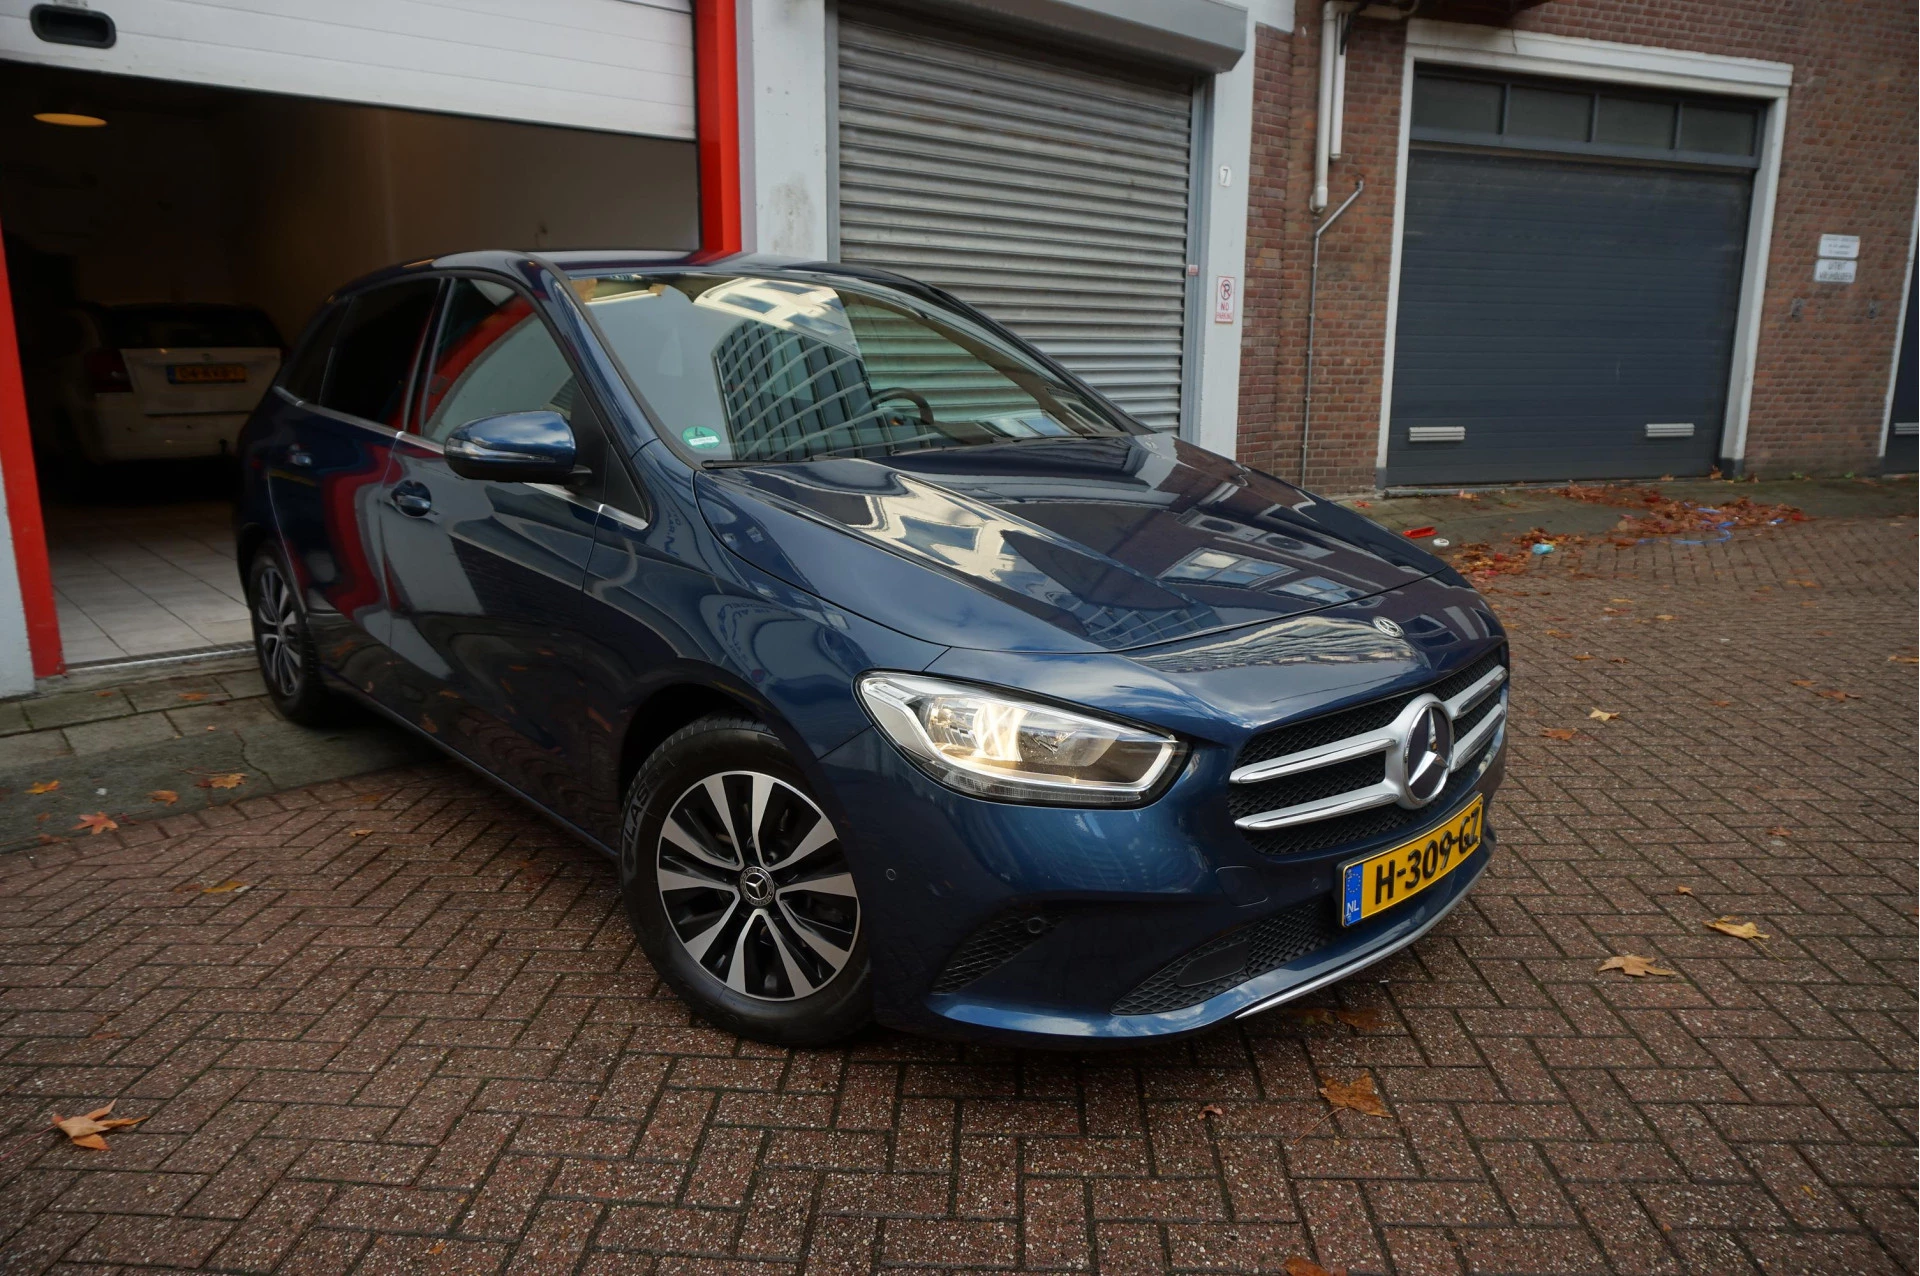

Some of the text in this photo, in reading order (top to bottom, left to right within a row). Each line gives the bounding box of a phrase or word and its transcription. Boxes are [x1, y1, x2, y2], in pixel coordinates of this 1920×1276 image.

[1223, 168, 1229, 184] 7
[1221, 302, 1230, 312] NO
[1375, 805, 1481, 905] H-309-GZ
[1346, 899, 1360, 915] NL
